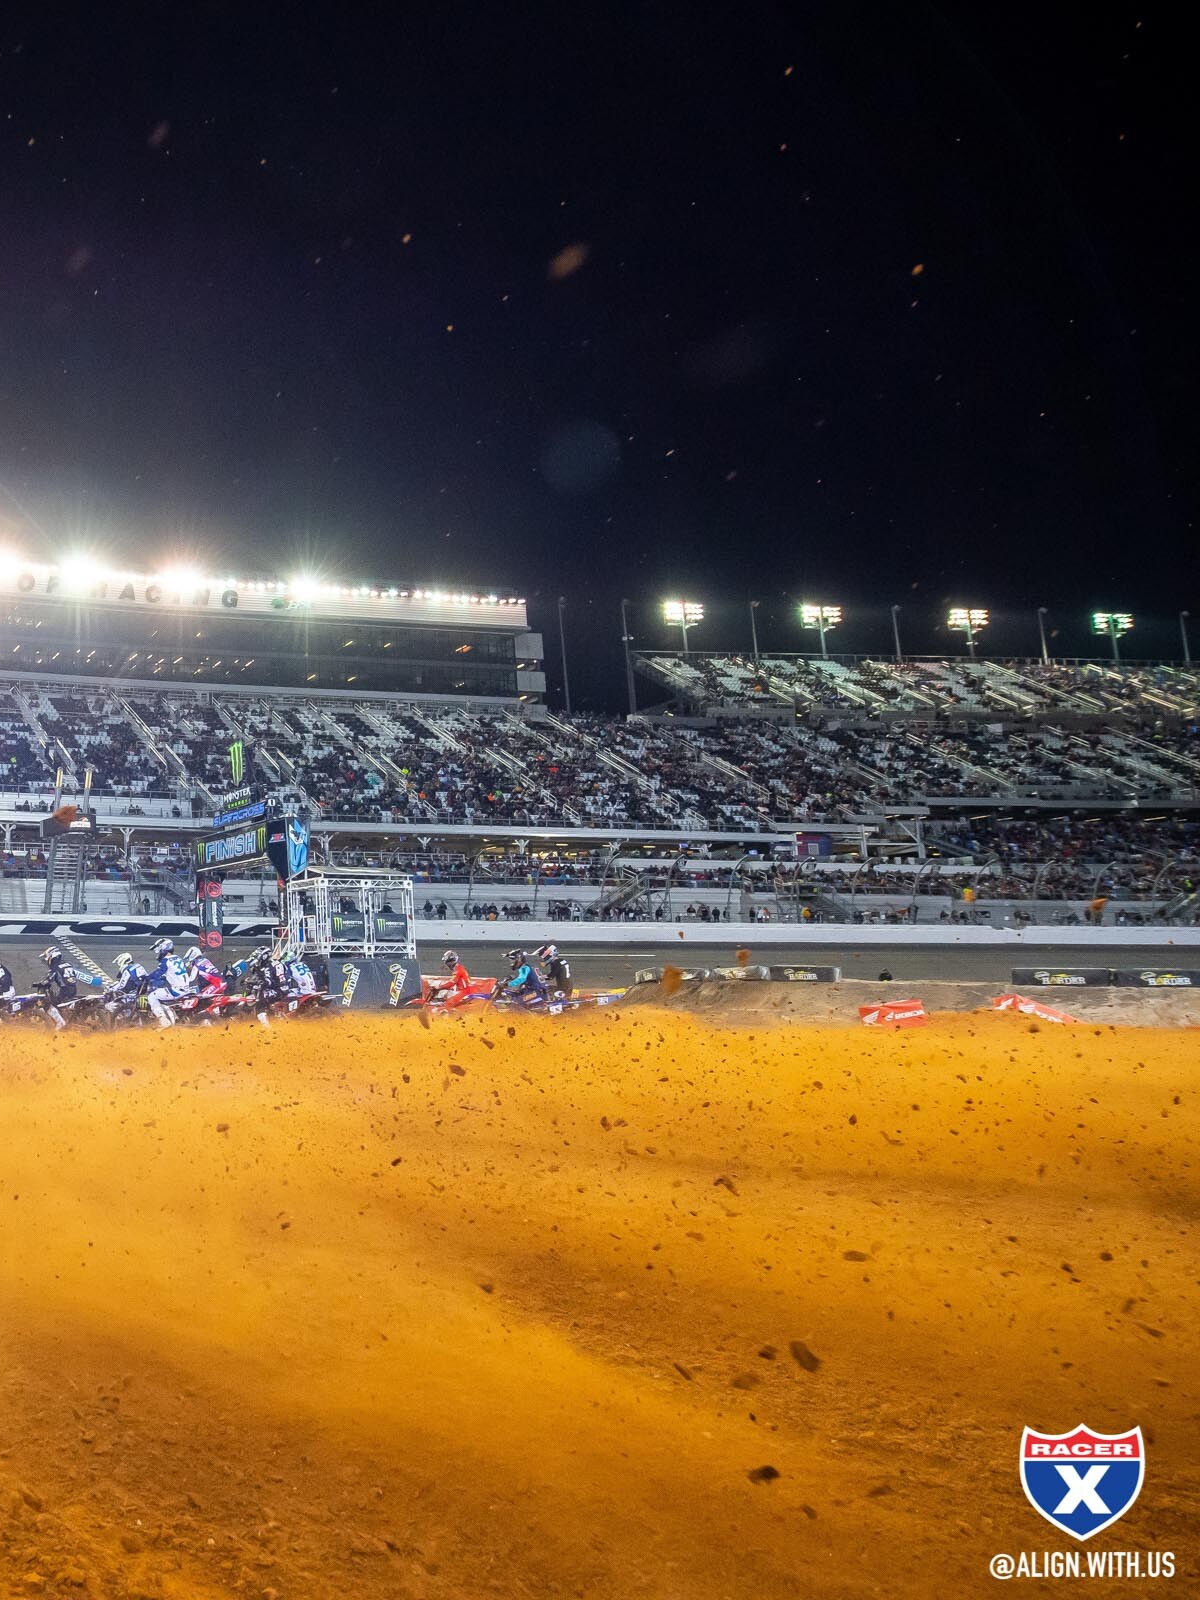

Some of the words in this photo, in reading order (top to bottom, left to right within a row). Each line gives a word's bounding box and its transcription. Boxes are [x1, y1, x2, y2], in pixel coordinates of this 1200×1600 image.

[206, 831, 257, 864] FINISH
[1042, 976, 1087, 985] HARDER
[1147, 976, 1192, 986] HARDER
